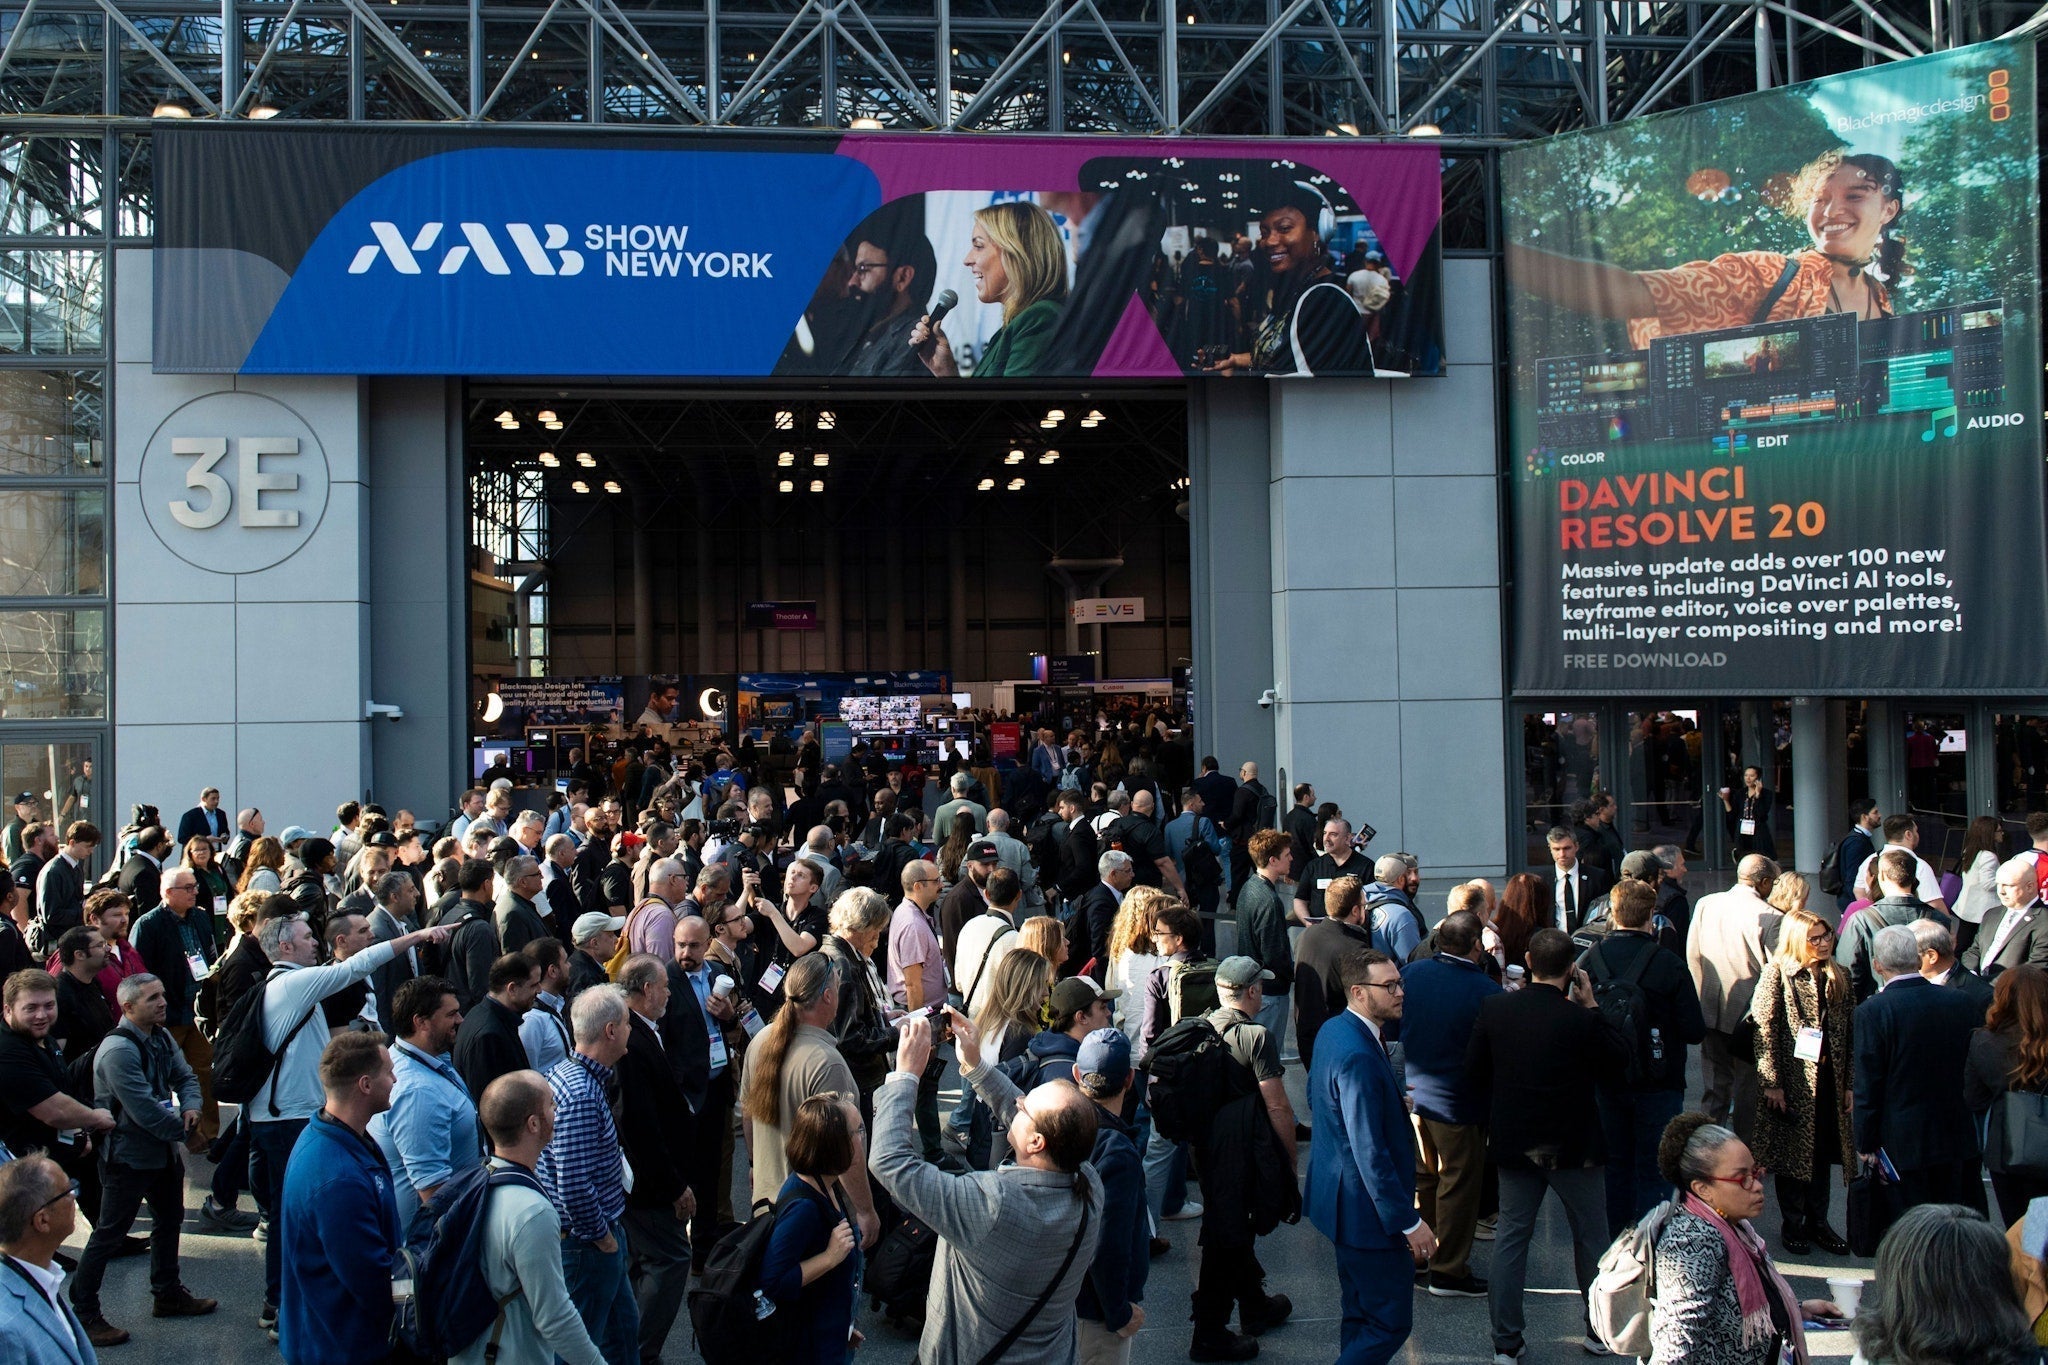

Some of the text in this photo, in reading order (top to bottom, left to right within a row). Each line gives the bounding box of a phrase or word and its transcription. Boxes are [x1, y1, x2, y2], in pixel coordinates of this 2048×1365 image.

[1836, 93, 1986, 132] Blackmagicdesign
[348, 221, 585, 276] NAB
[584, 223, 689, 252] SHOW
[1967, 413, 2024, 430] AUDIO
[1757, 434, 1789, 448] EDIT
[1561, 451, 1604, 466] COLOR
[169, 437, 301, 529] 3E
[1560, 466, 1745, 512] DAVINCI
[1561, 502, 1826, 550] RESOLVE 20
[1562, 548, 1946, 580] Massive update adds over 100 new
[1562, 568, 1952, 599] features including DaVinci AI tools,
[1096, 604, 1134, 616] EVS
[1563, 592, 1960, 623] keyframe editor, voice over palettes,
[1563, 615, 1962, 644] multi-layer compositing and more!
[1564, 652, 1726, 668] FREE DOWNLOAD
[529, 691, 565, 699] Hollywood
[567, 690, 590, 699] digital
[574, 698, 613, 707] production!
